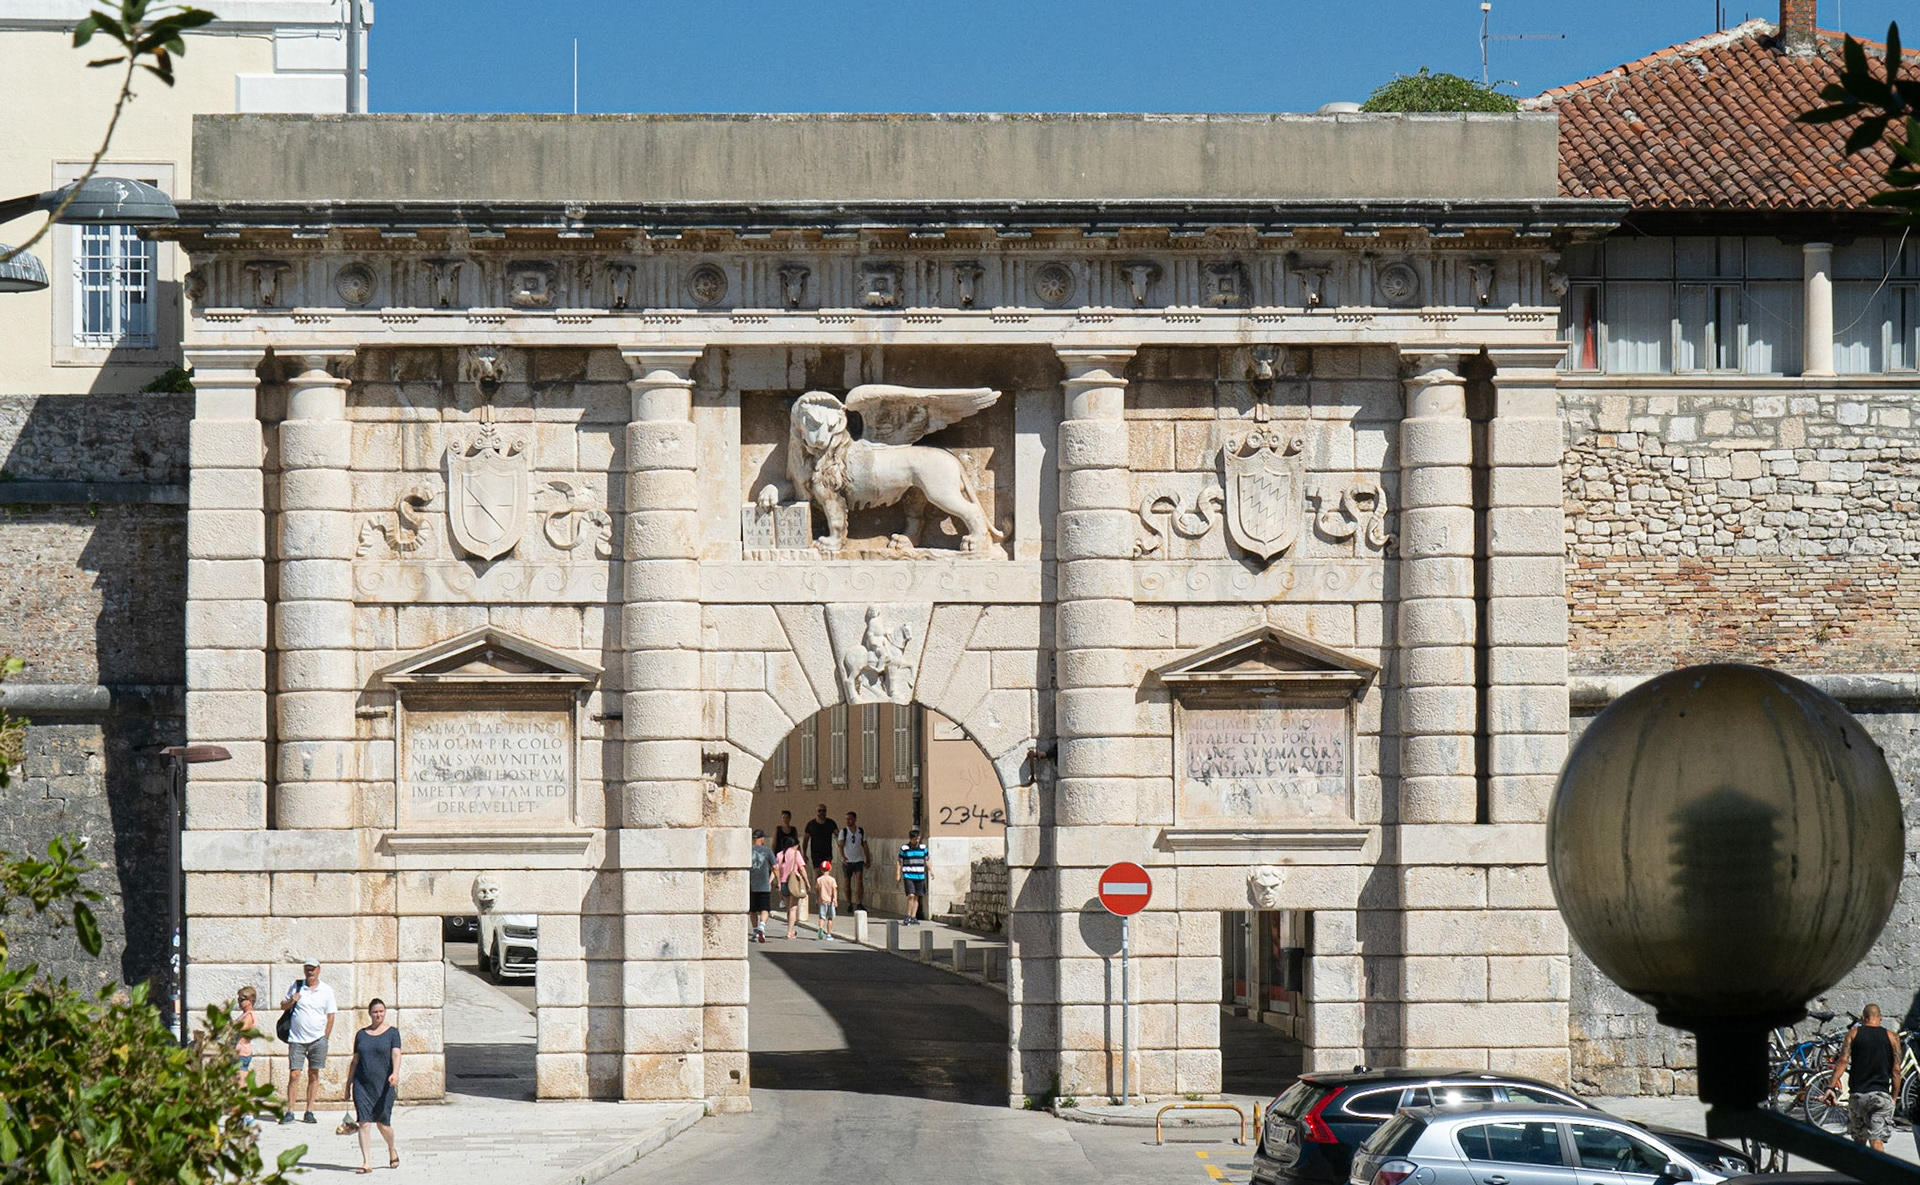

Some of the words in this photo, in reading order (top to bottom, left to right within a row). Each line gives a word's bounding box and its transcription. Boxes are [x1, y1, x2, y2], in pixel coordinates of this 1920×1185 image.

[411, 723, 502, 735] DALMATIAE
[508, 723, 562, 735] PRINCI
[412, 738, 439, 750] PEM
[536, 785, 566, 797] RED
[437, 801, 475, 813] DERE
